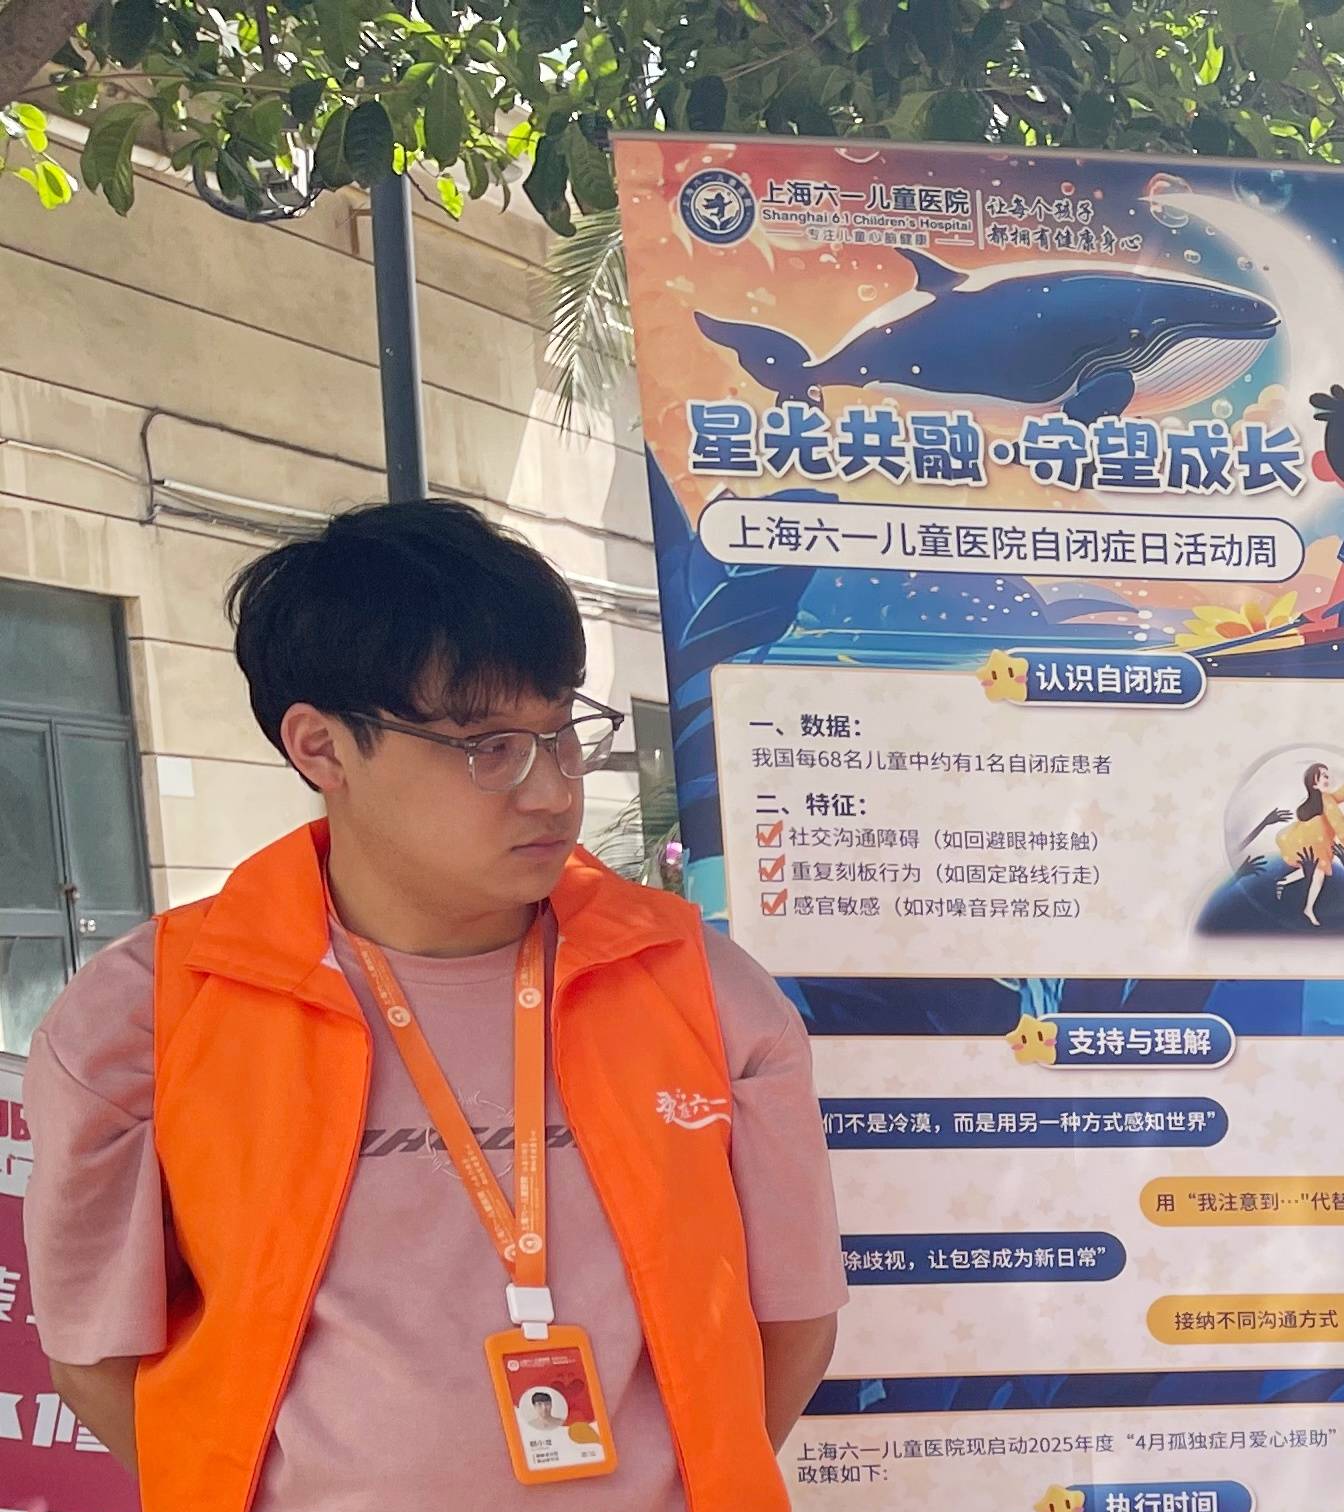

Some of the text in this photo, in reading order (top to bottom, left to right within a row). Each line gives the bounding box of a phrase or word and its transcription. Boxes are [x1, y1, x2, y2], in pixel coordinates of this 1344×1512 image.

[761, 180, 971, 215] 上海六一儿童医院
[986, 196, 1094, 224] 让每个孩子
[762, 209, 828, 225] Shanghai
[920, 217, 972, 232] Hospital
[806, 227, 928, 248] 专注儿童心脑健康
[986, 226, 1141, 254] 都拥有健康身心
[688, 400, 1305, 496] 星光共融·守望成长
[727, 513, 1279, 570] 上海六一儿童医院自闭症日活动周
[1036, 662, 1183, 696] 认识自闭症
[751, 746, 1112, 777] 我国每68名儿童中约有1名自闭症患者
[1068, 1028, 1211, 1056] 支持与理解
